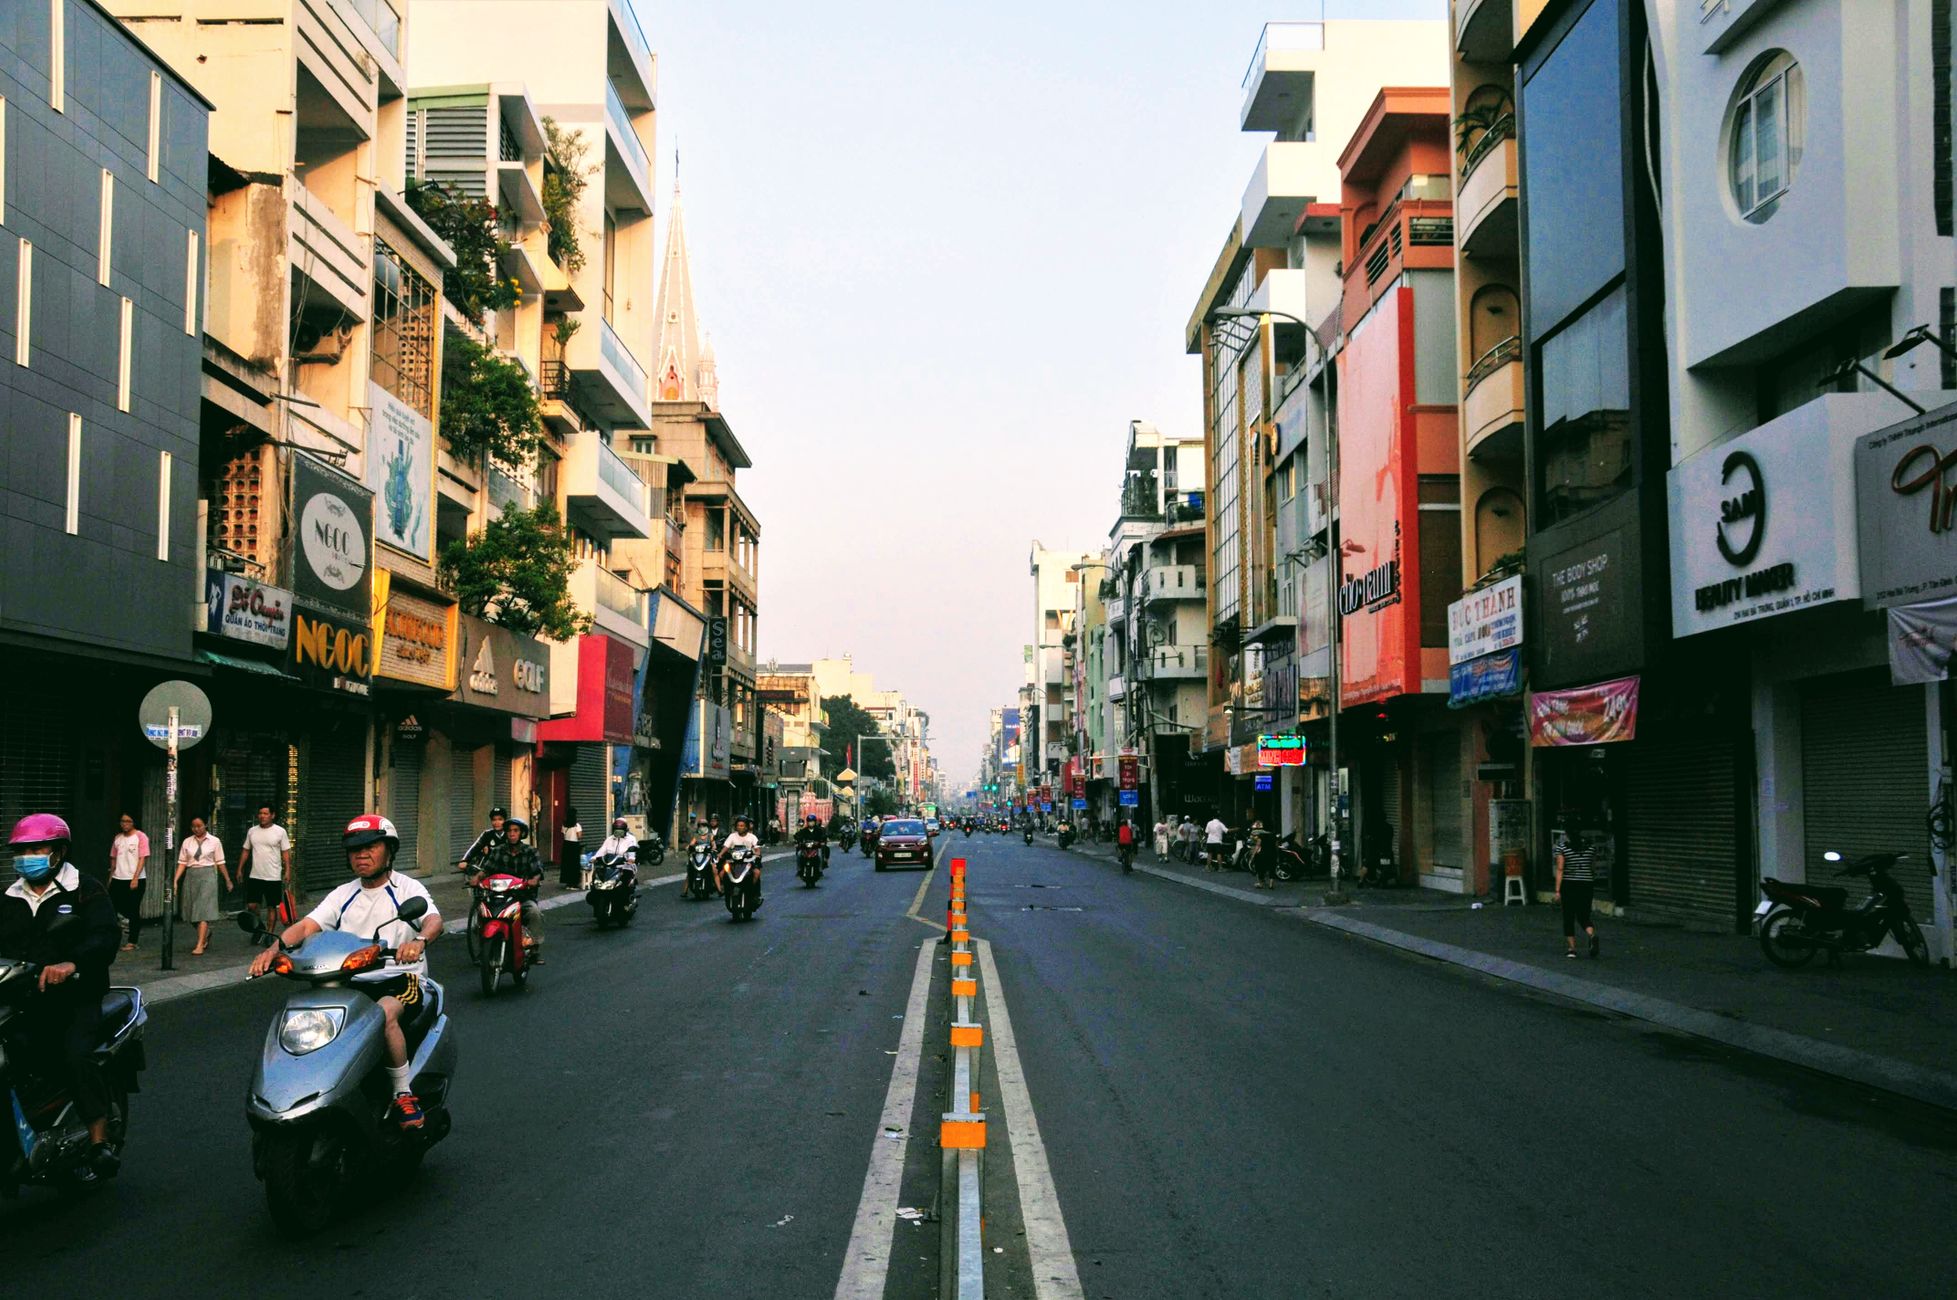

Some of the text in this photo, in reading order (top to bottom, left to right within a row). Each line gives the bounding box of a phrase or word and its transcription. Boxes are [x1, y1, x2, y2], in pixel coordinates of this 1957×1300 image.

[1552, 553, 1608, 586] THE BODY SHOP
[712, 621, 725, 661] Sea
[469, 672, 498, 696] adidas
[513, 658, 545, 694] GOLF
[397, 724, 423, 732] adidas
[1256, 783, 1272, 791] ATM
